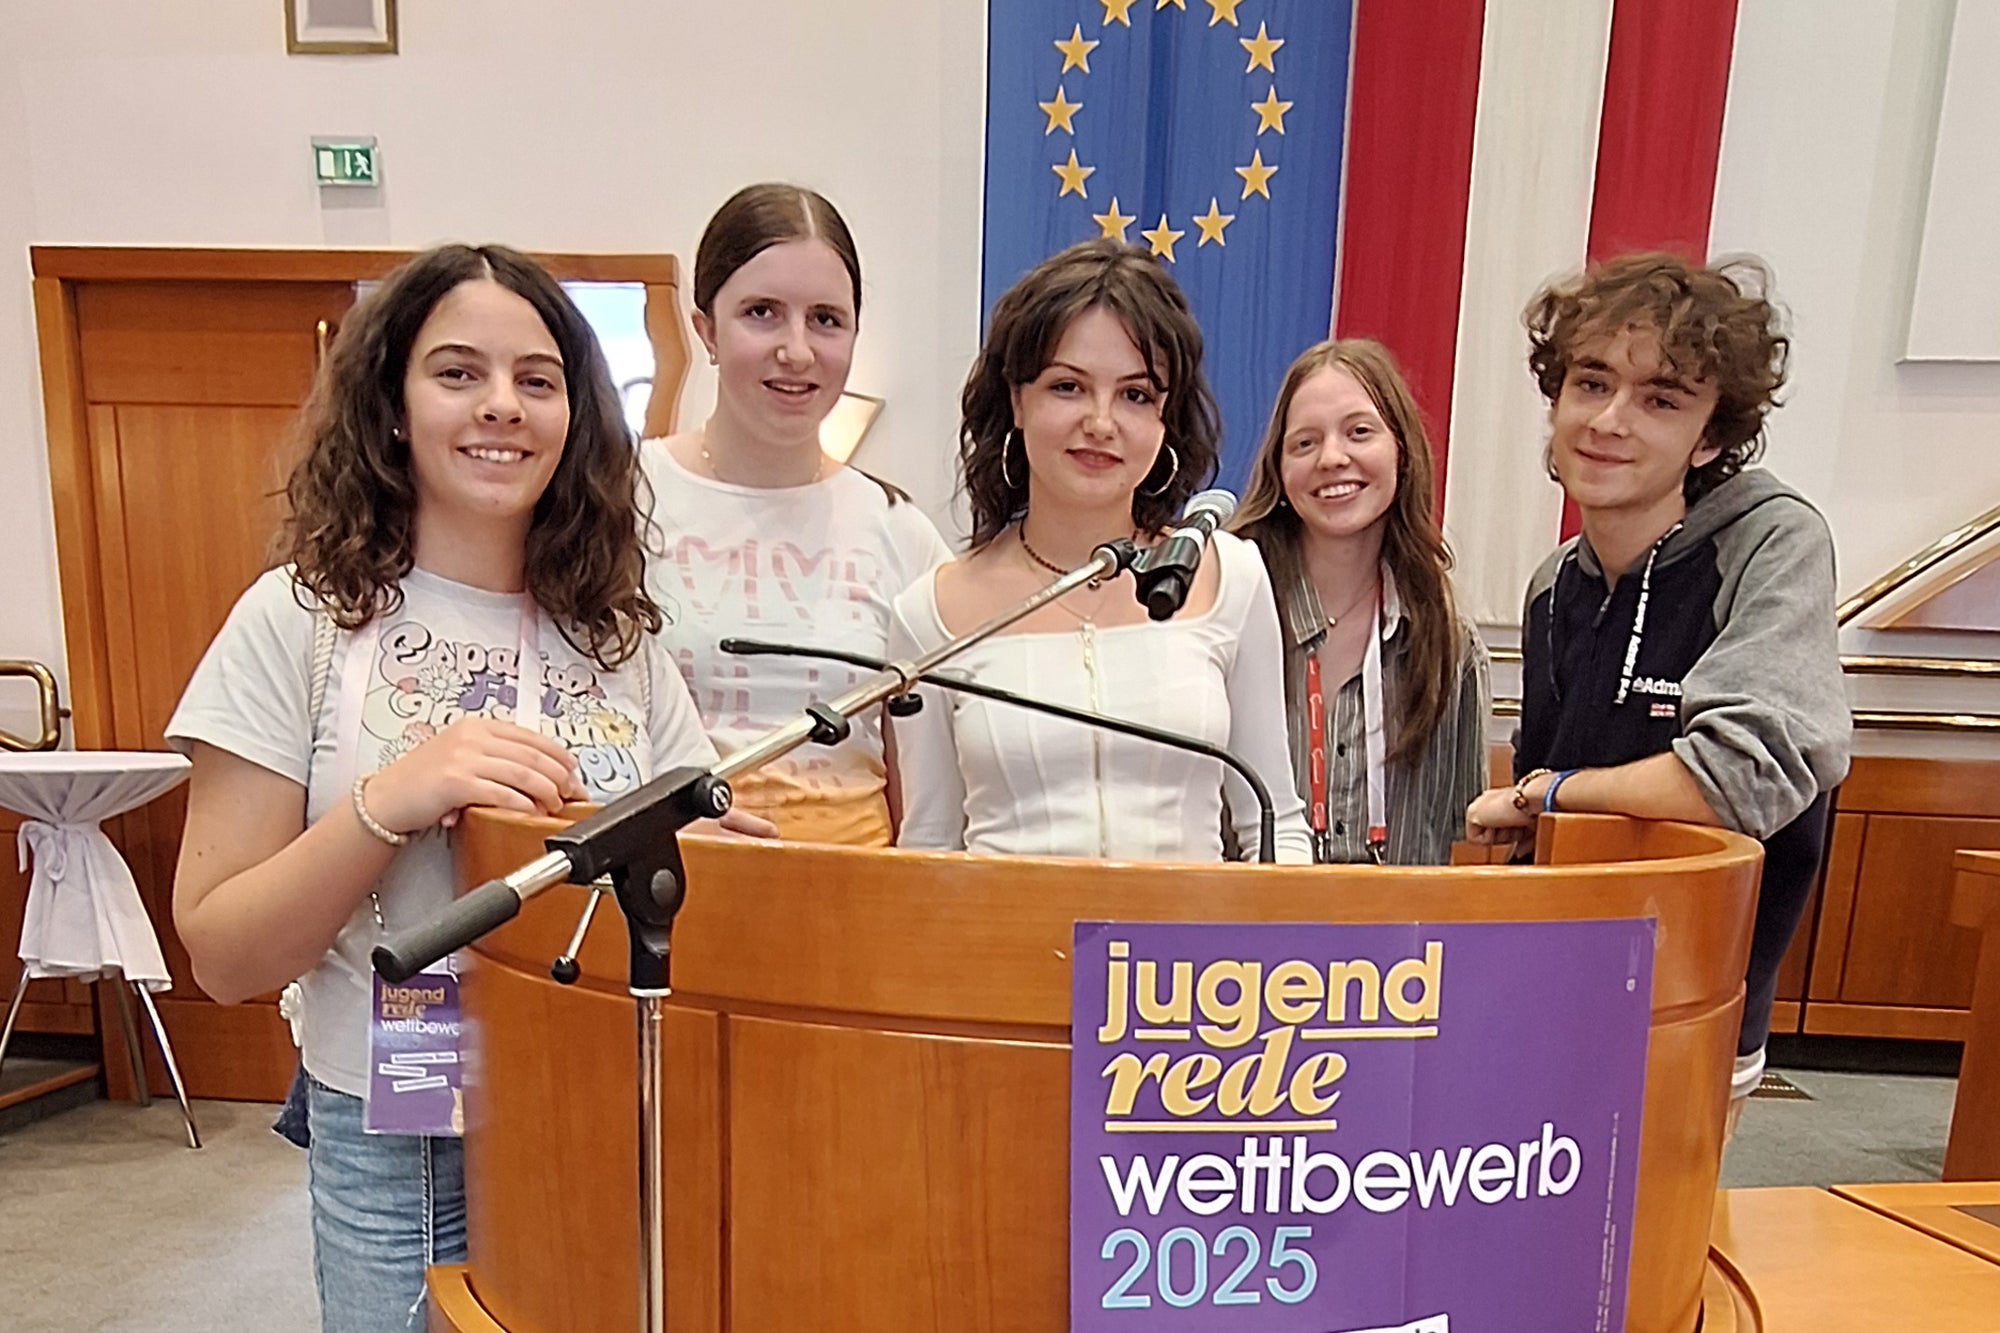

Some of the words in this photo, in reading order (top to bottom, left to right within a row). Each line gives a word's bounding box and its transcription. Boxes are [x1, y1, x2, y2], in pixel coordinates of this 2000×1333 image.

[379, 621, 597, 698] Espaa
[381, 983, 445, 1004] jugend
[1098, 941, 1443, 1047] jugend
[1101, 1026, 1348, 1116] rede
[1099, 1121, 1582, 1216] wettbewerb
[1100, 1225, 1318, 1309] 2025
